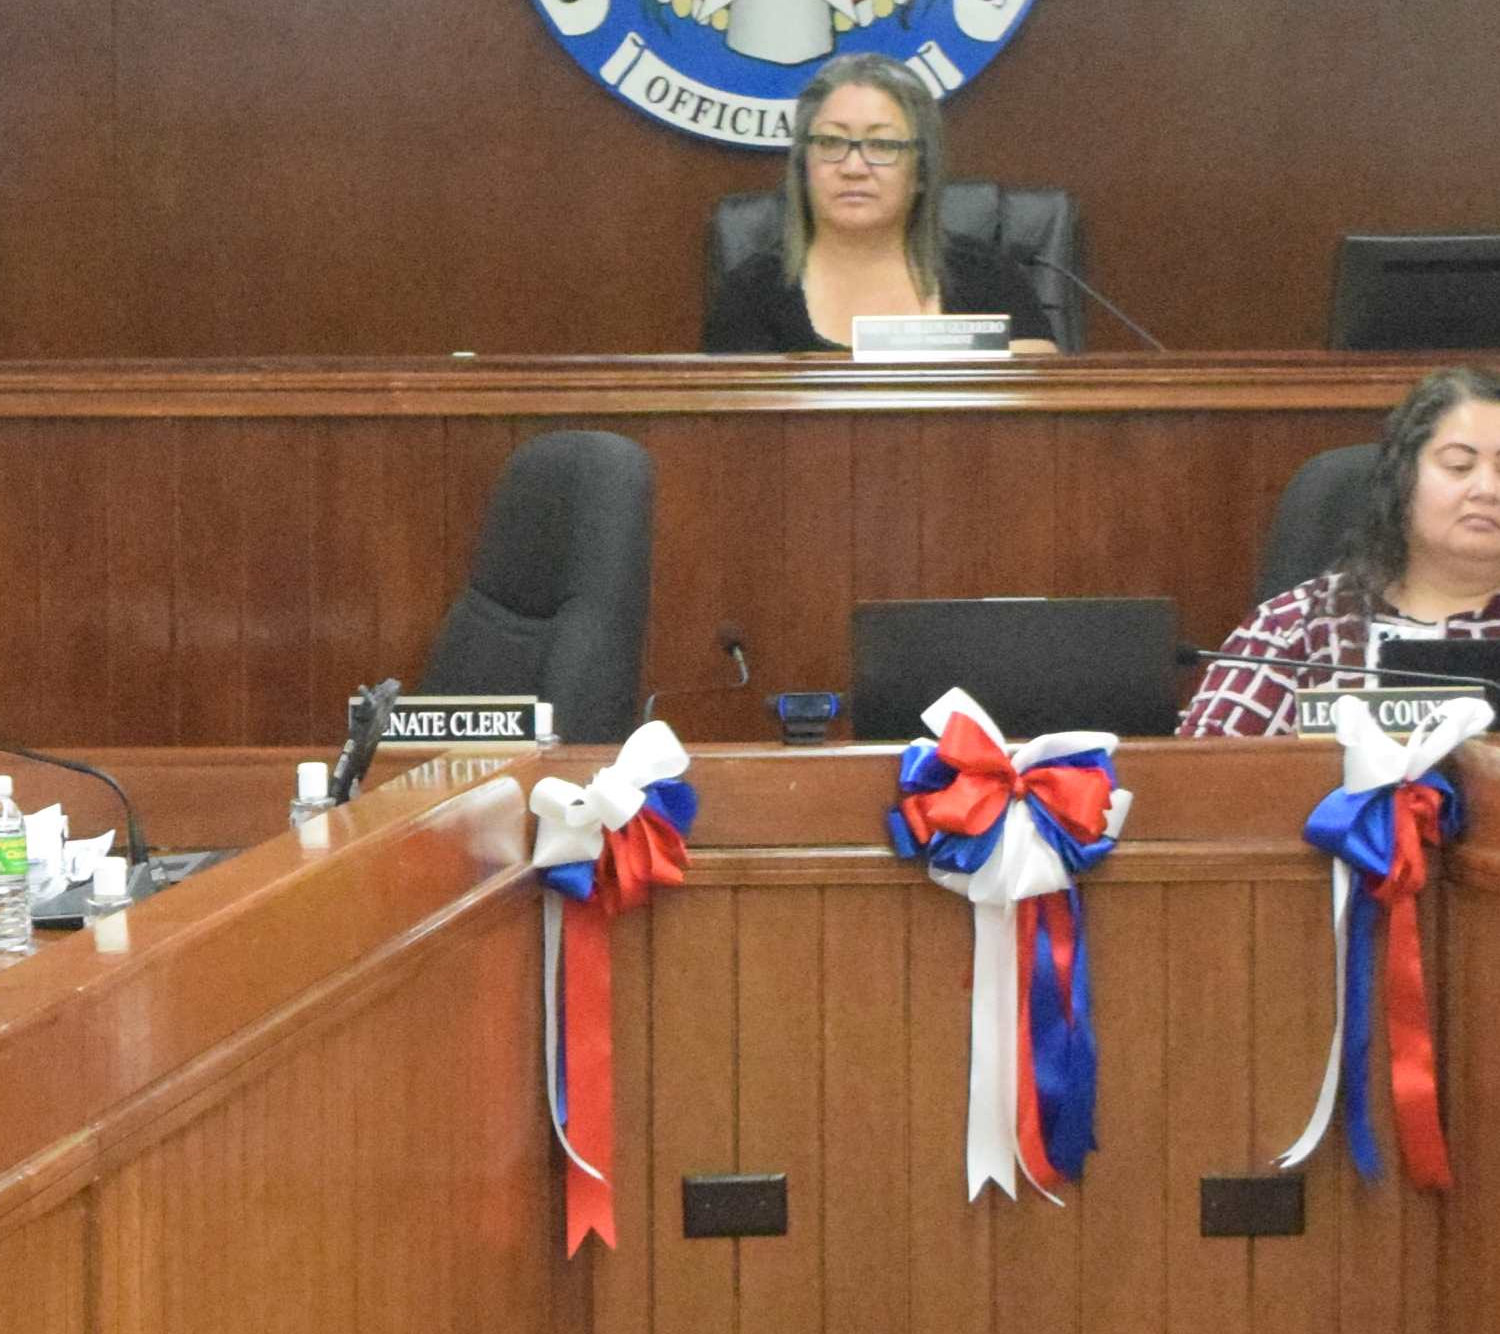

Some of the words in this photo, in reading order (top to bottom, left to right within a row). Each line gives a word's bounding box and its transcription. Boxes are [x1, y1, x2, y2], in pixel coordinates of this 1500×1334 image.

[645, 74, 793, 139] OFFICIA
[381, 711, 447, 736] NATE
[450, 711, 524, 736] CLERK
